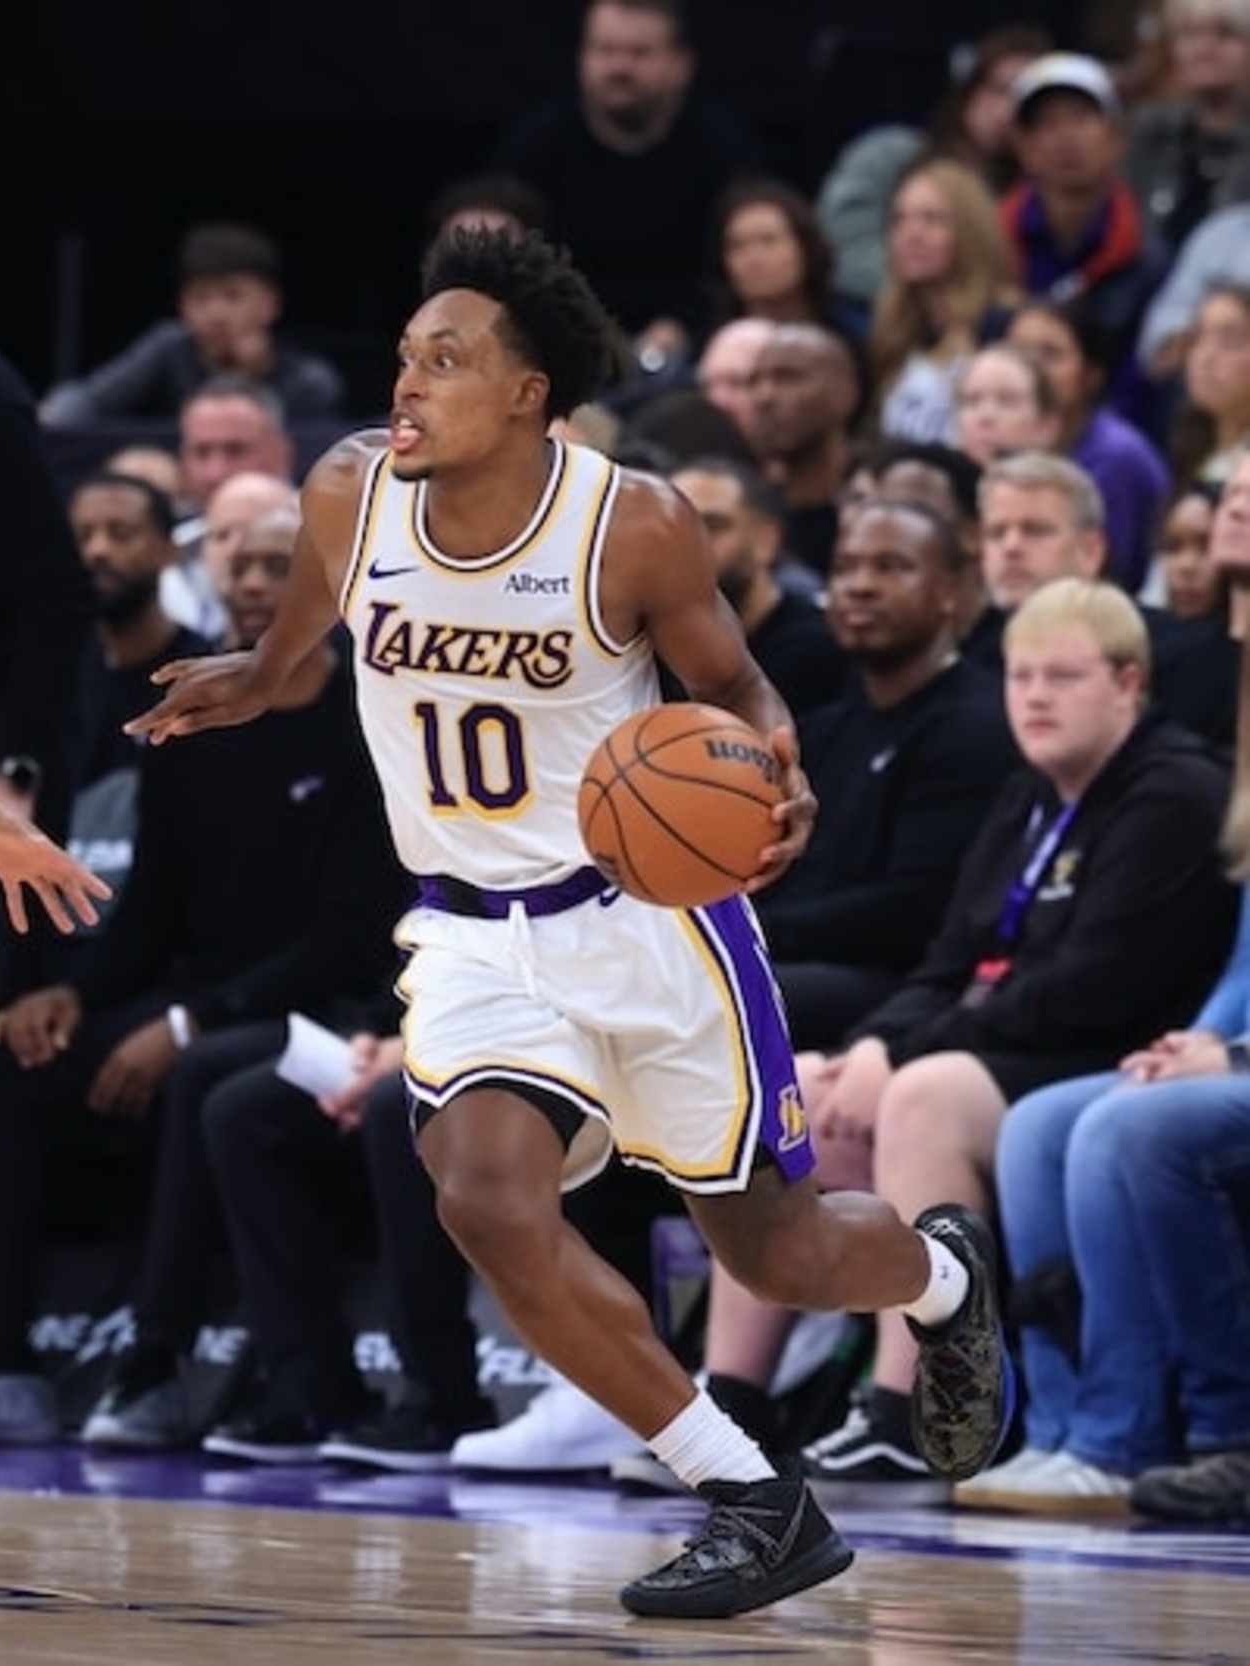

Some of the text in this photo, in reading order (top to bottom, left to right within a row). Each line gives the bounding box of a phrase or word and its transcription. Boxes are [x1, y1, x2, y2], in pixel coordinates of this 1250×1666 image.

[504, 574, 570, 595] Albert
[363, 600, 575, 690] LAKERS
[412, 701, 535, 818] 10
